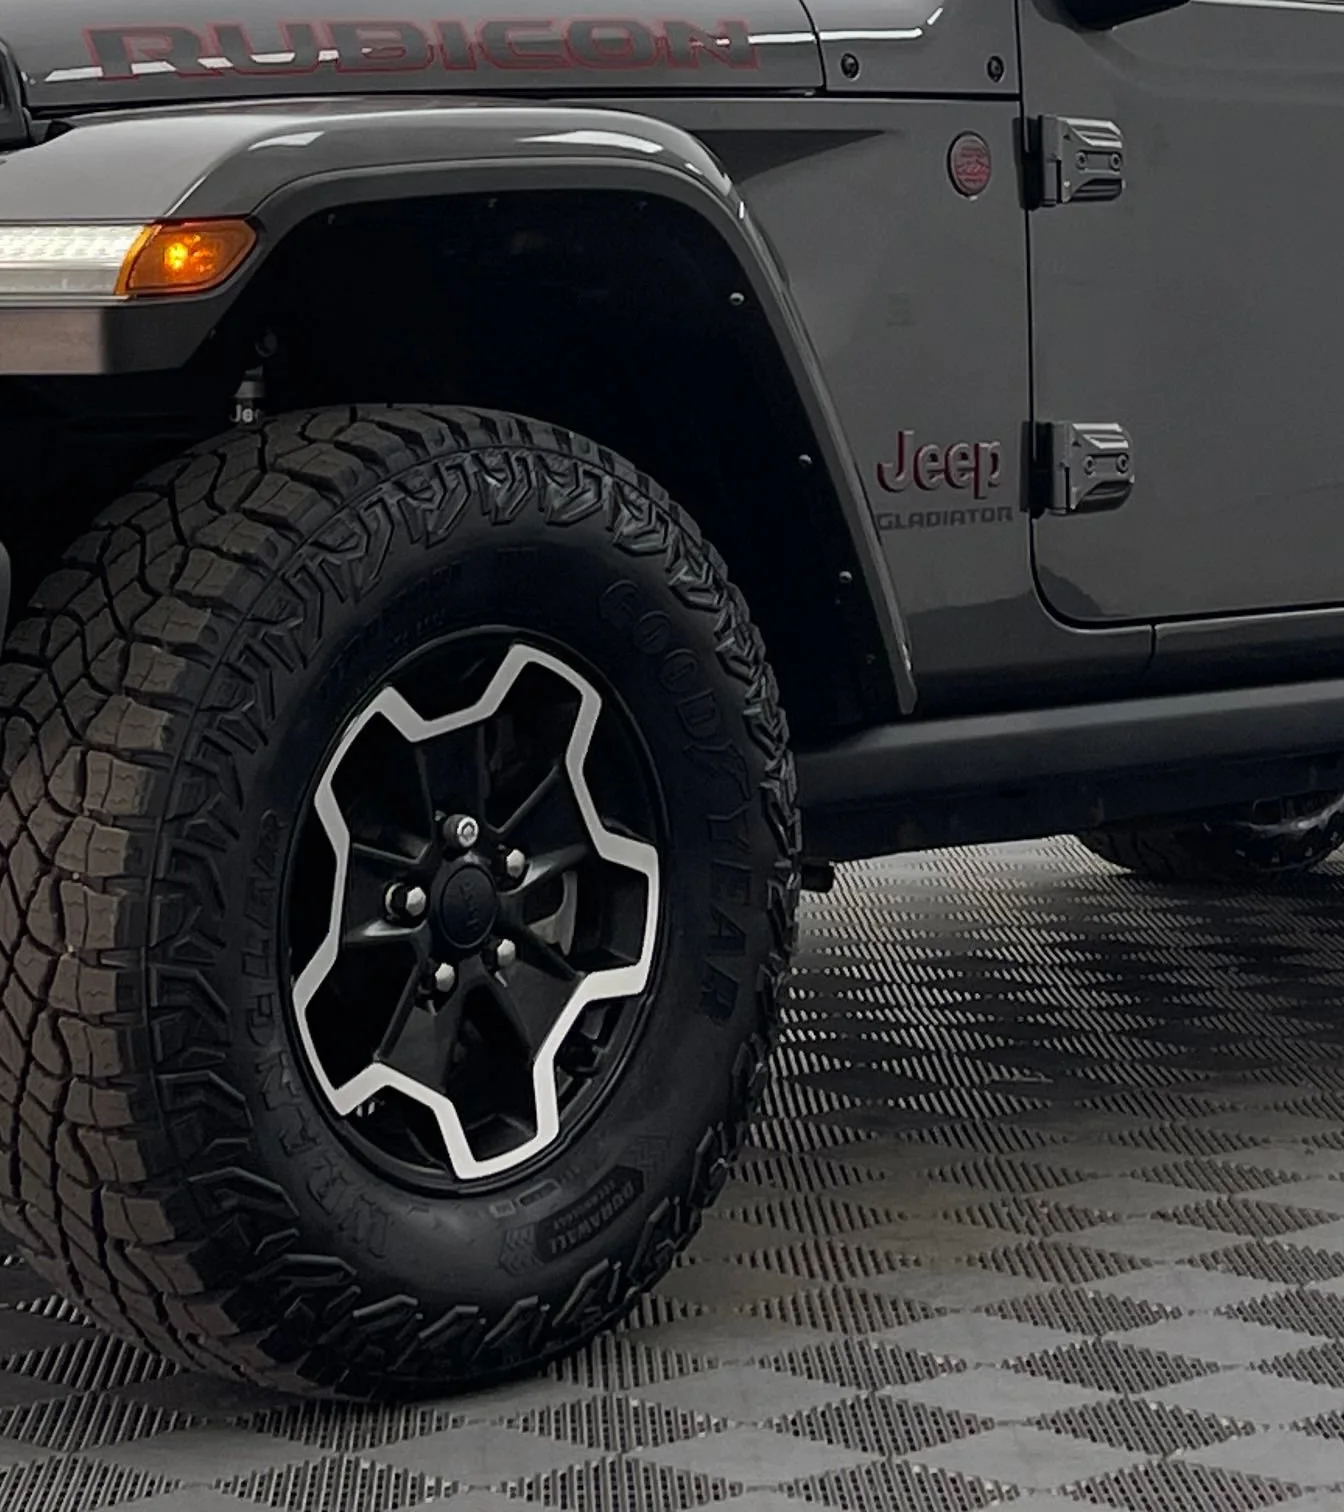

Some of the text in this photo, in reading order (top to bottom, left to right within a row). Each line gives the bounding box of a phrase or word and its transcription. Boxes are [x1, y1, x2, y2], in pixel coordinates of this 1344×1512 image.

[82, 16, 761, 81] RUBICON
[877, 429, 1001, 500] Jeep
[877, 505, 1014, 531] GLADIATOR
[596, 578, 751, 1021] GOODYEAR
[551, 1179, 636, 1254] DURAWALL
